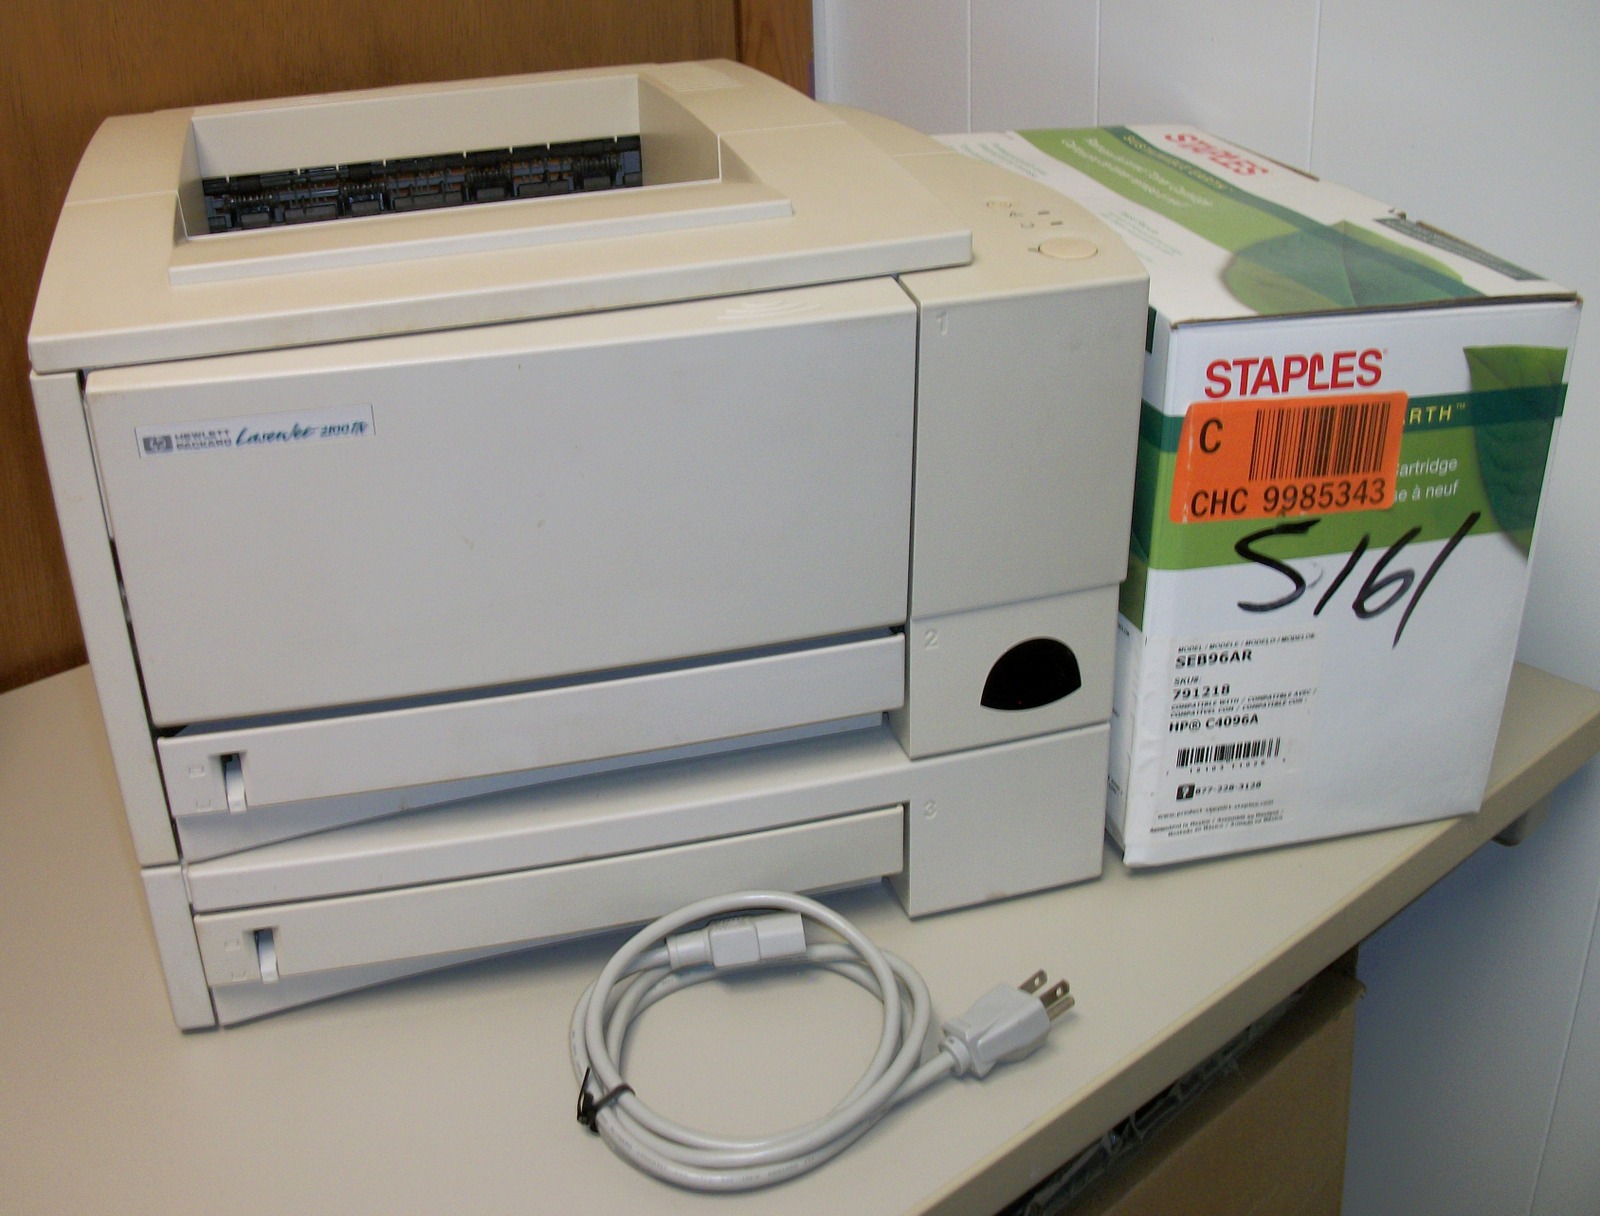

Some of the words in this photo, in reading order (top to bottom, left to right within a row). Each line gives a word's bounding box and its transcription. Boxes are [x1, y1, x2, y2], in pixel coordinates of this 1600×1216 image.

[1204, 347, 1383, 399] STAPLES
[174, 429, 231, 441] HEWLETT
[175, 438, 233, 451] PACKARD
[235, 421, 315, 448] LaserJet
[1199, 418, 1224, 454] C
[1395, 457, 1458, 480] artridge
[1190, 487, 1249, 519] CHC
[1262, 477, 1387, 515] 9985343
[1411, 484, 1421, 501] à
[1425, 480, 1460, 500] neuf
[1173, 683, 1231, 701] 791218
[1205, 713, 1259, 730] C4096A
